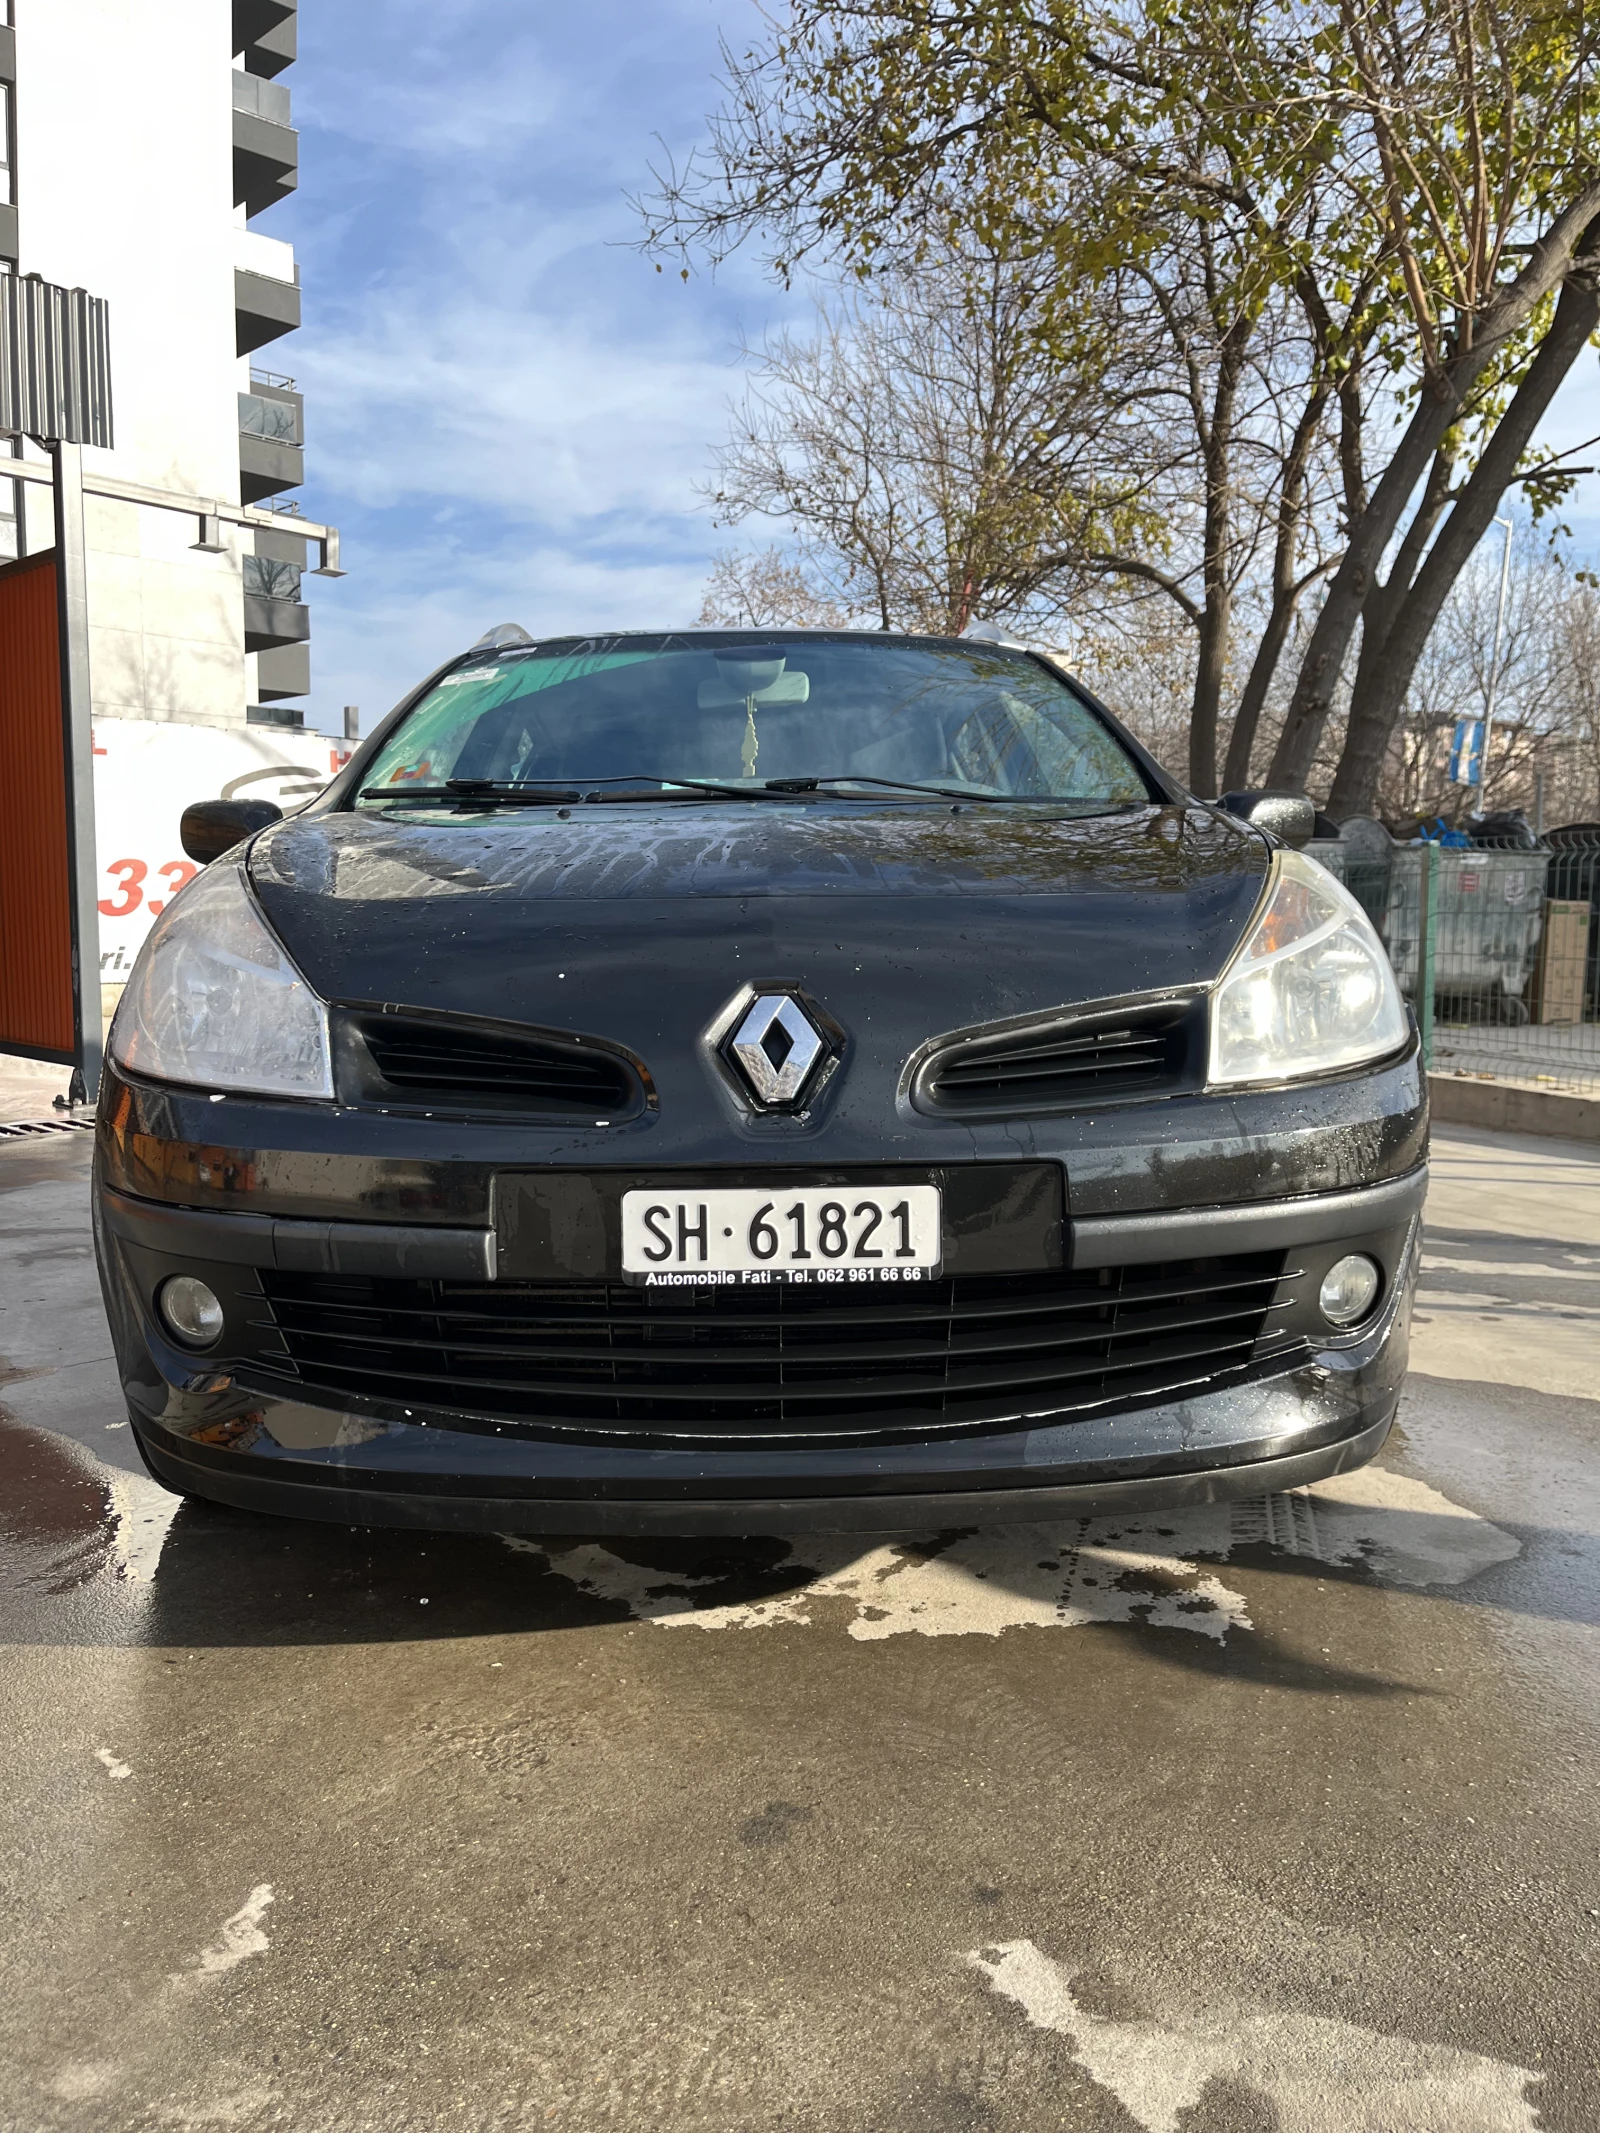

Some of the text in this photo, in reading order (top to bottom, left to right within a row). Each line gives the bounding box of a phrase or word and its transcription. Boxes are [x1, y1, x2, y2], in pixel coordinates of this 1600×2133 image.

[643, 1203, 708, 1262] SH
[749, 1200, 917, 1260] 61821
[645, 1272, 736, 1286] Automobile
[742, 1270, 771, 1284] Fati
[785, 1269, 813, 1283] Tel.
[817, 1269, 845, 1282] 062
[848, 1268, 875, 1282] 961
[880, 1267, 899, 1281] 66
[902, 1267, 921, 1281] 66
